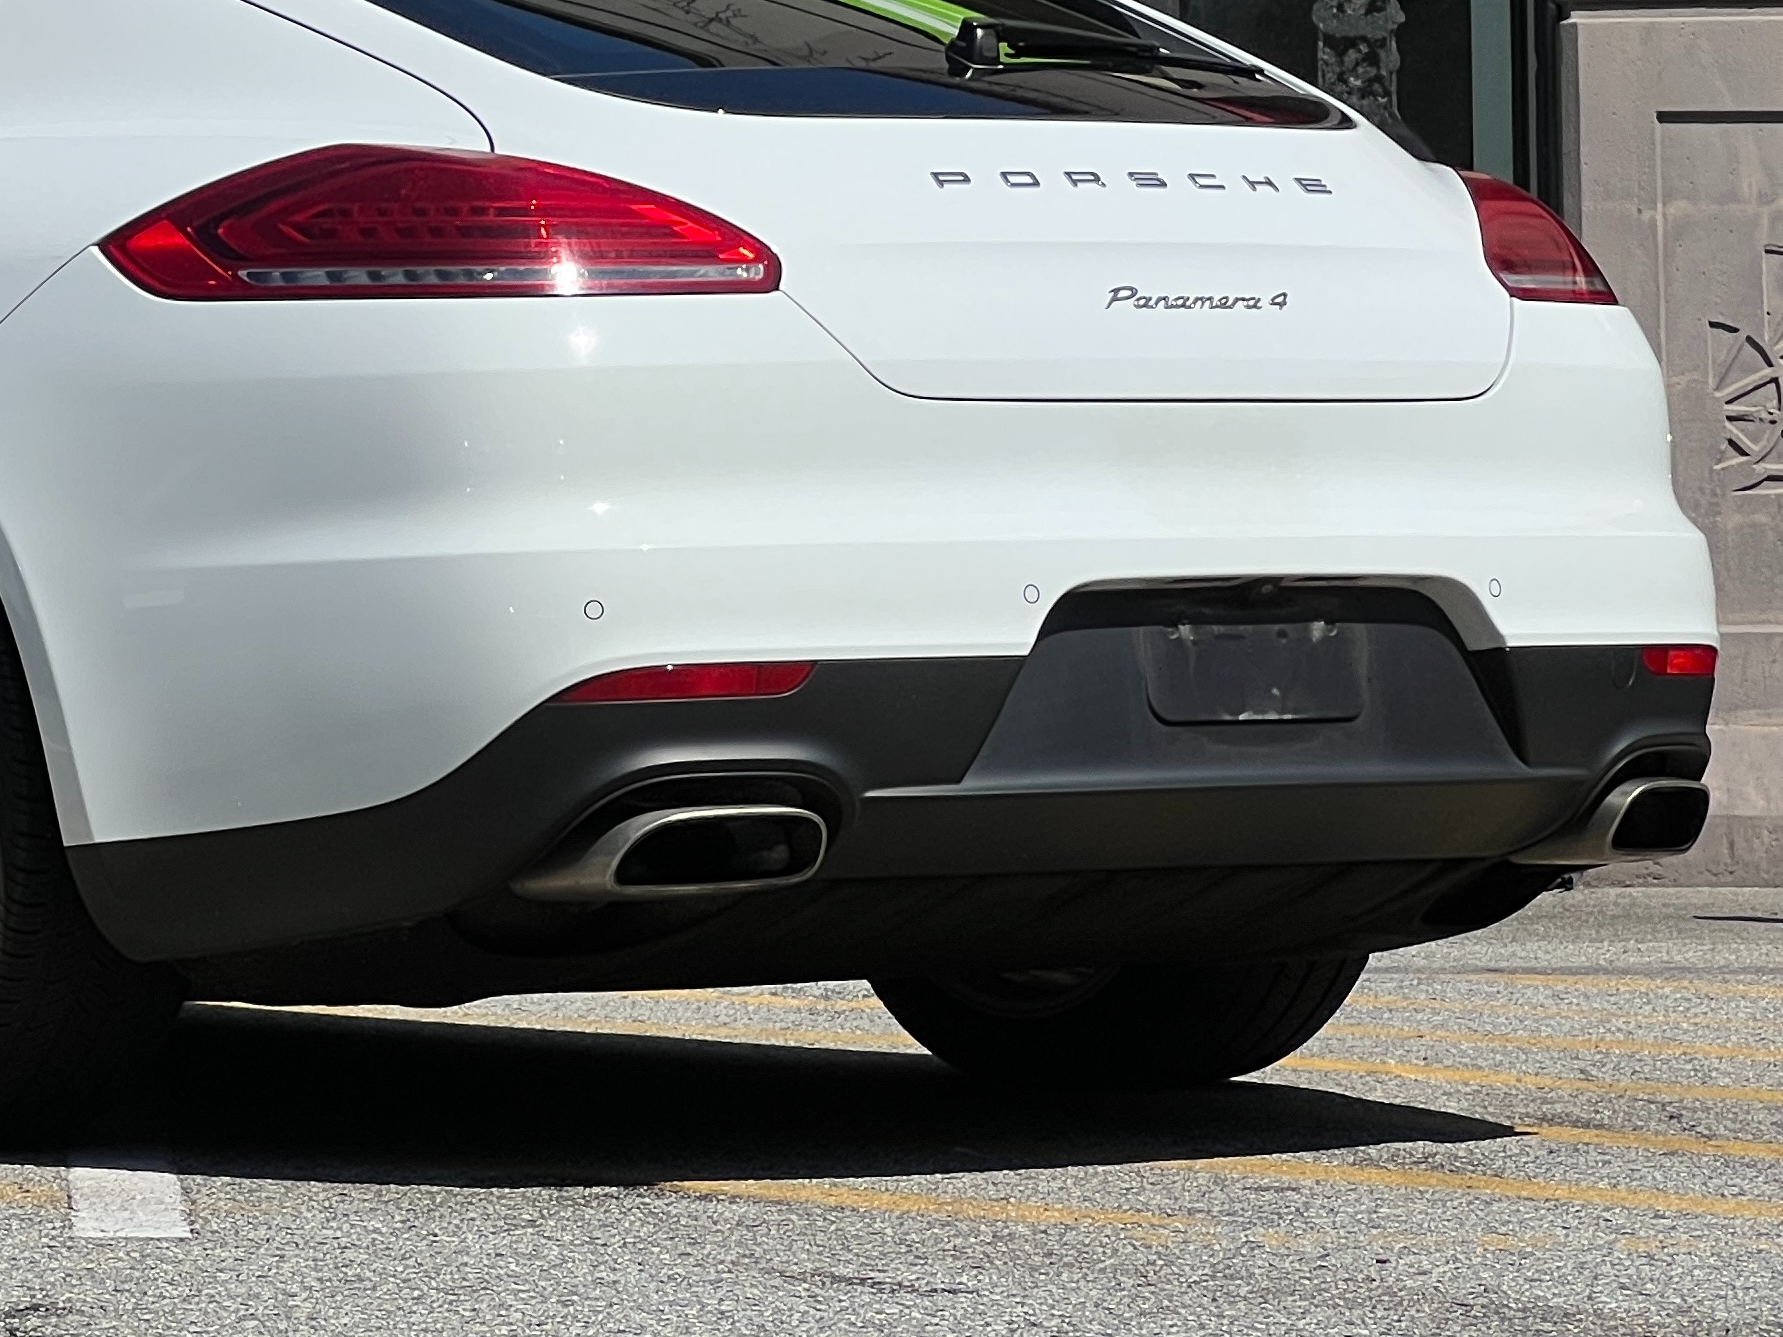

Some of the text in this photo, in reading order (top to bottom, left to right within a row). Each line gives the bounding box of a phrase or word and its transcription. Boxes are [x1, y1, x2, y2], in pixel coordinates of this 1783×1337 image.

[929, 171, 1333, 195] PORSCHE
[1105, 285, 1289, 311] Panamera 4
